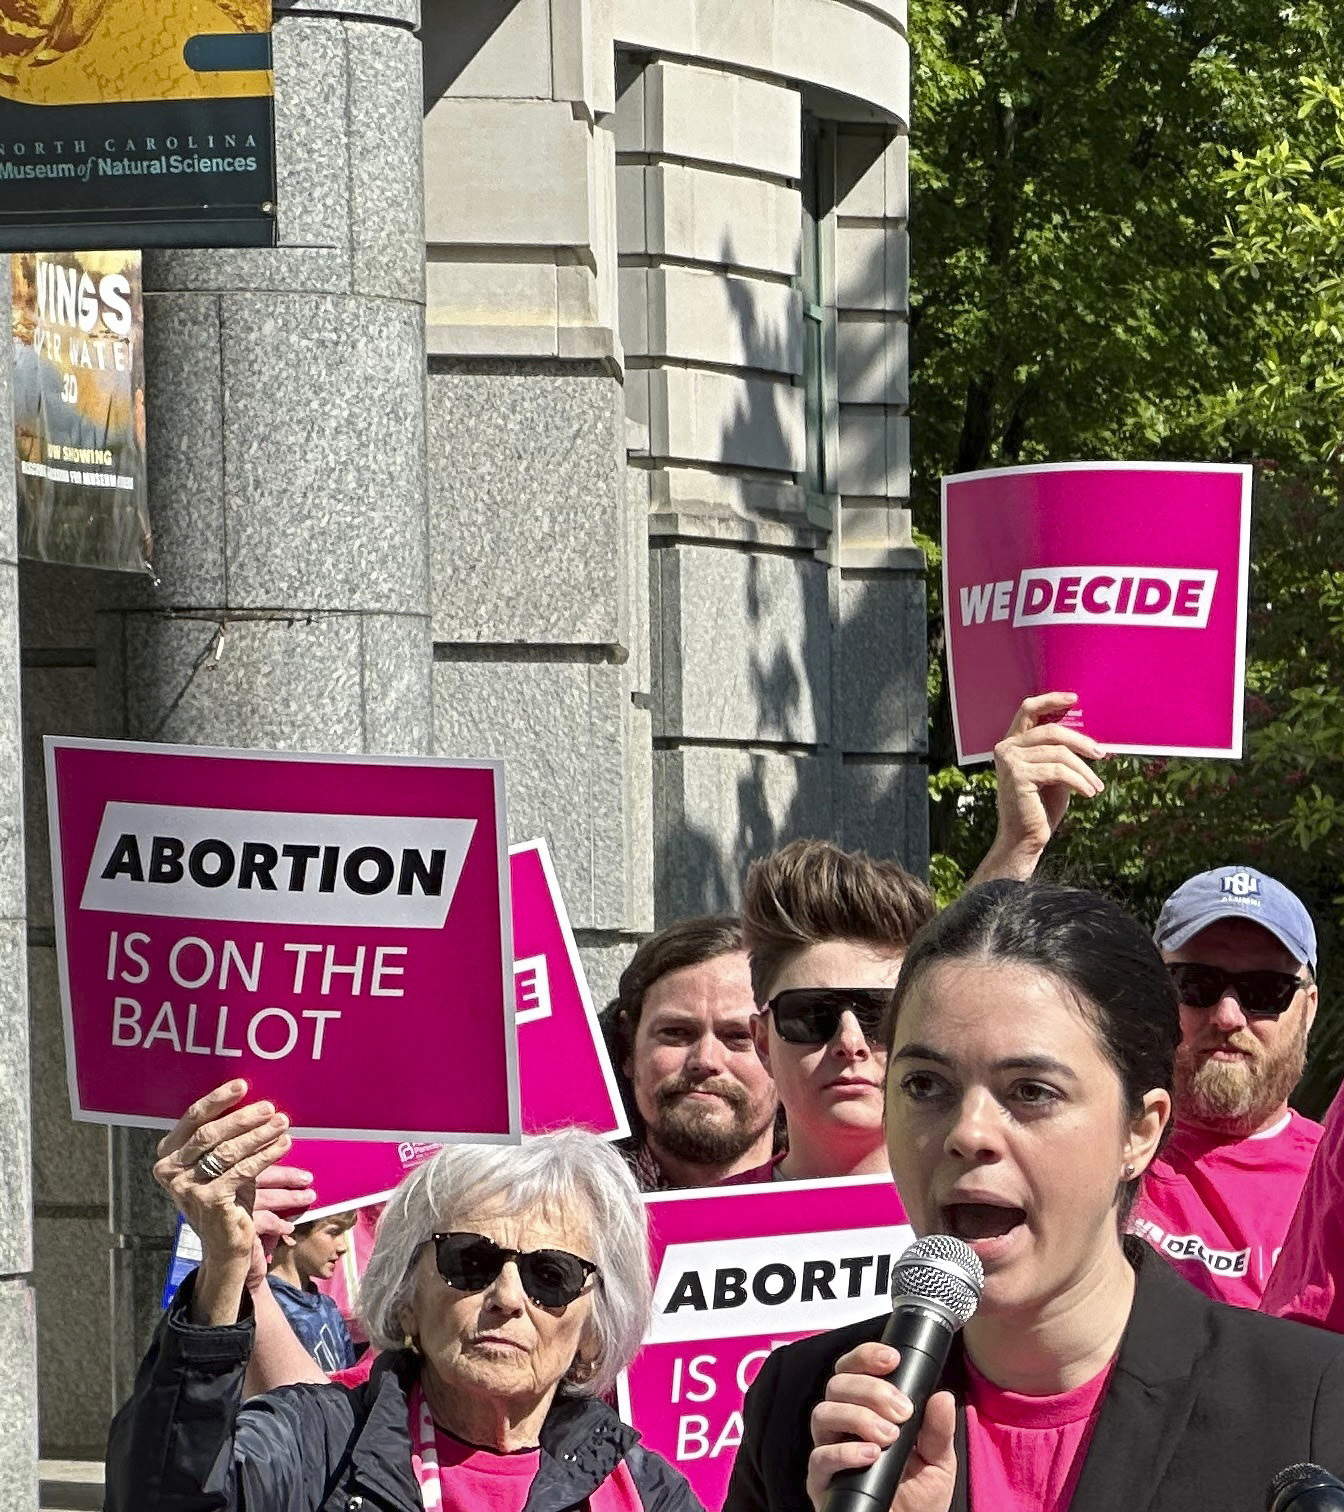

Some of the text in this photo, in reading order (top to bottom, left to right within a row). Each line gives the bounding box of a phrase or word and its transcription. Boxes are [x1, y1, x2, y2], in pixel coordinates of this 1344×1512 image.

[0, 154, 257, 182] Museum of Natural Sciences
[105, 135, 256, 151] CAROLINA
[960, 575, 1206, 627] WE DECIDE
[100, 833, 447, 897] ABORTION
[107, 931, 408, 997] IS ON THE
[112, 997, 342, 1060] BALLOT
[662, 1254, 891, 1314] ABORTI
[671, 1354, 717, 1404] IS
